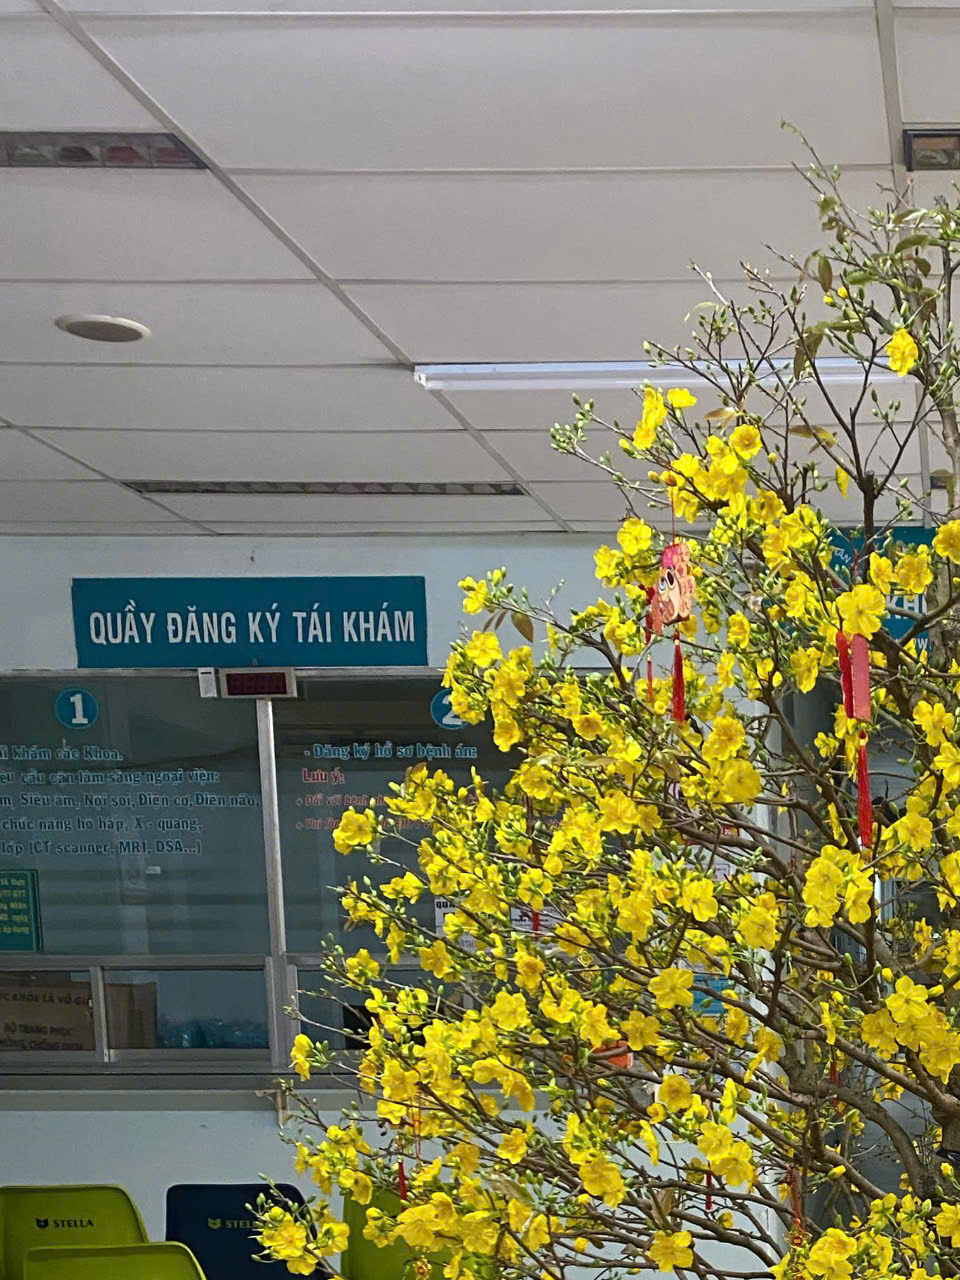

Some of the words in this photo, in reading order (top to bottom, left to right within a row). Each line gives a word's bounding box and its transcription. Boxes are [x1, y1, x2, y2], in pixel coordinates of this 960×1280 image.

[89, 599, 156, 646] QUẦY
[166, 605, 237, 644] ĐĂNG
[247, 602, 281, 643] KÝ
[292, 602, 332, 643] TÁI
[343, 601, 416, 643] KHÁM
[69, 693, 89, 724] 1
[313, 743, 350, 760] Đăng
[353, 742, 370, 760] ký
[375, 741, 393, 758] hồ
[396, 745, 414, 758] sơ
[416, 743, 452, 760] bệnh
[302, 768, 328, 782] Lưu
[134, 816, 143, 829] X
[53, 1218, 94, 1229] STELLA
